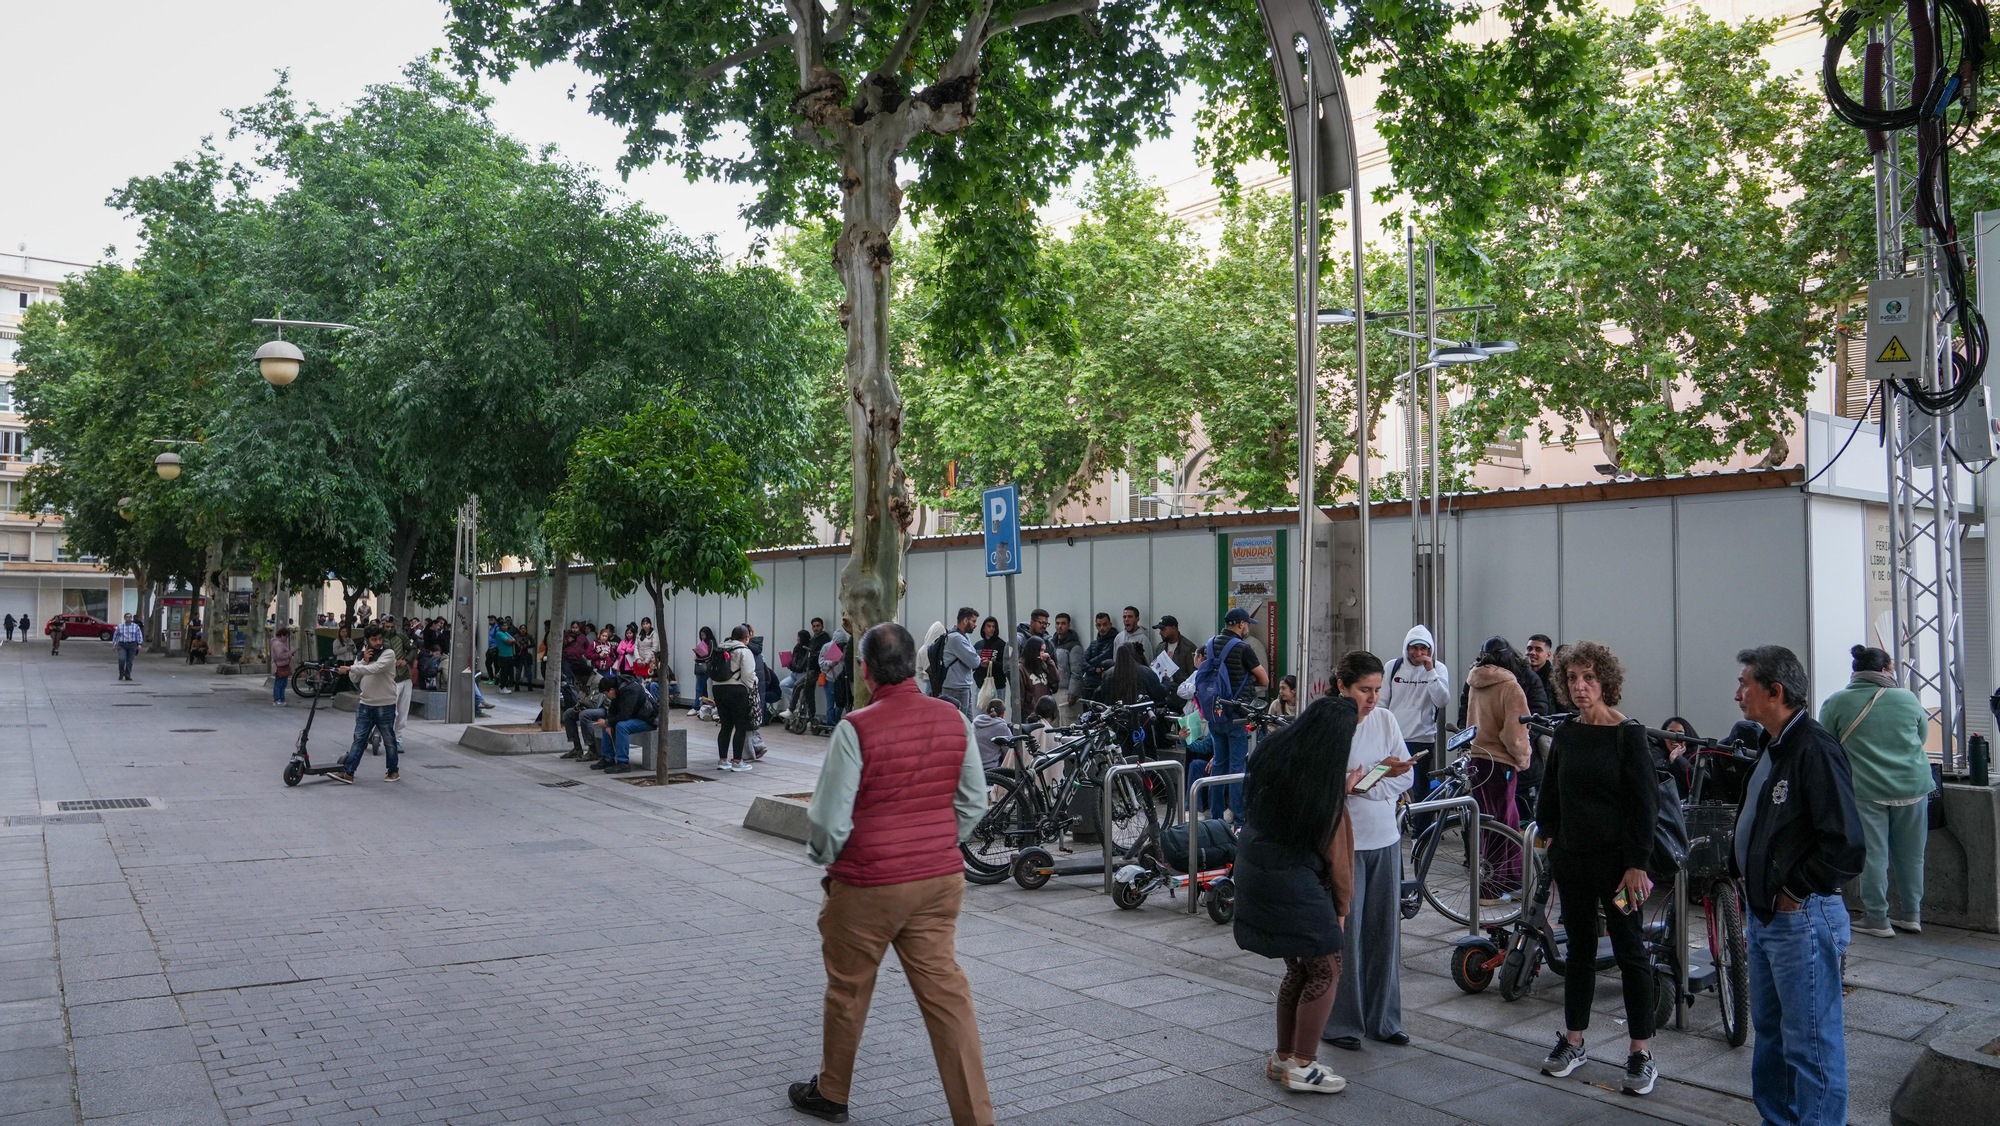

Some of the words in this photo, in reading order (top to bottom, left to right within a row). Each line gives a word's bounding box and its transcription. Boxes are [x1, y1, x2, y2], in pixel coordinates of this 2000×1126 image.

[991, 497, 1006, 533] P
[1233, 546, 1273, 558] MUNDAFA
[1870, 555, 1886, 565] LIBRO
[1872, 570, 1876, 580] Y
[1878, 570, 1885, 580] DE
[1393, 677, 1429, 686] Champion
